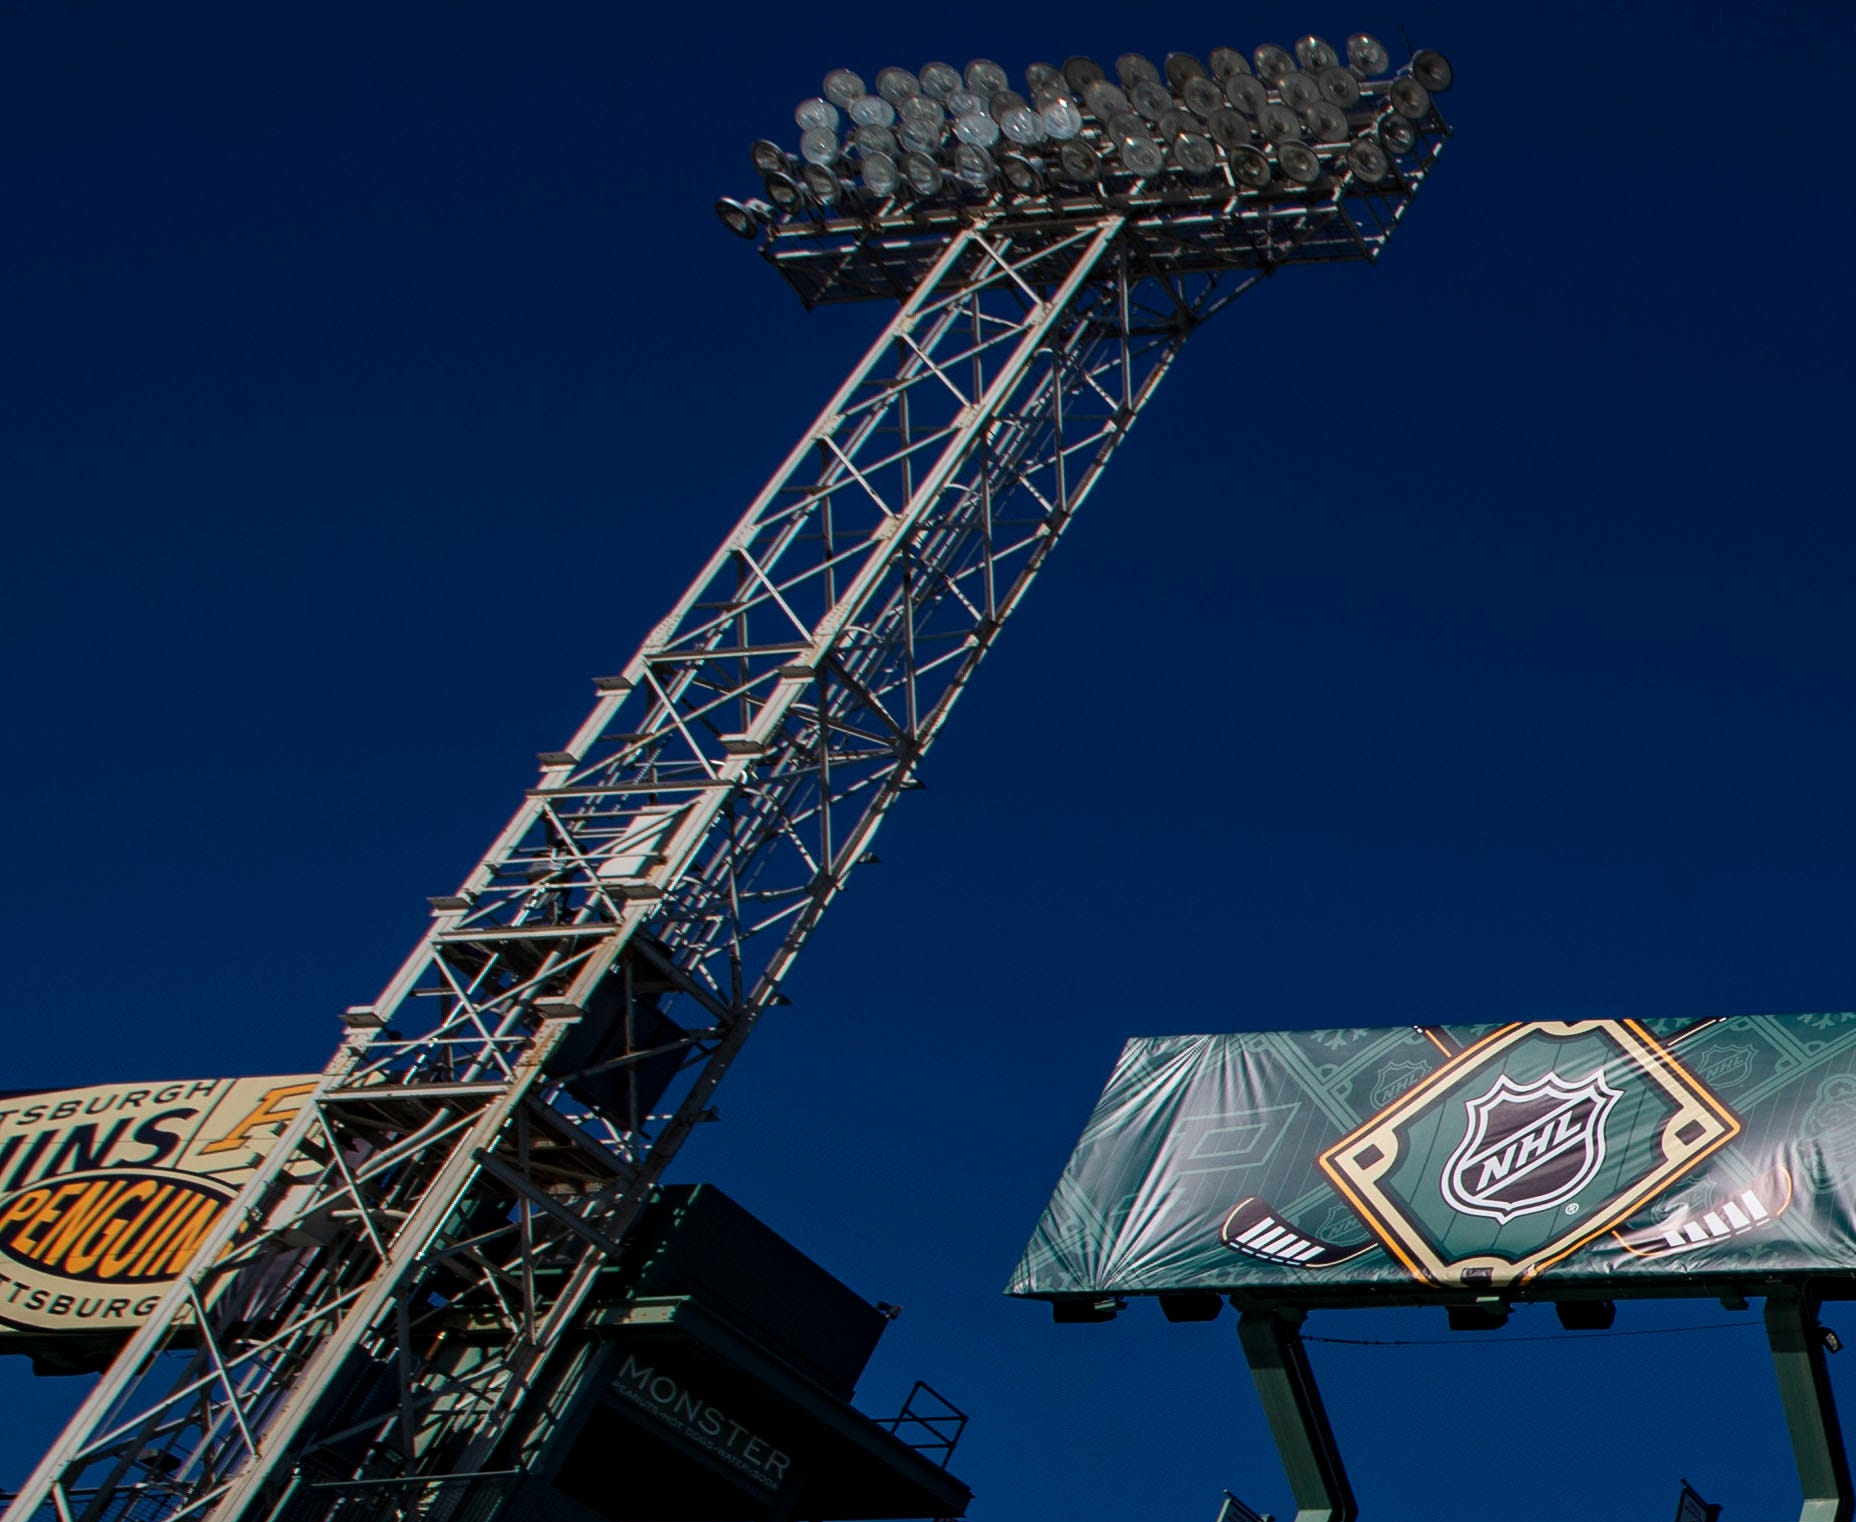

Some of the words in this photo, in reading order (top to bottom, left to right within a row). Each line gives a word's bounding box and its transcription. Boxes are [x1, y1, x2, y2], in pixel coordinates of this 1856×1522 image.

[1475, 1109, 1584, 1192] NHL
[0, 1177, 249, 1280] PENGUIN
[617, 1353, 792, 1481] MONSTER
